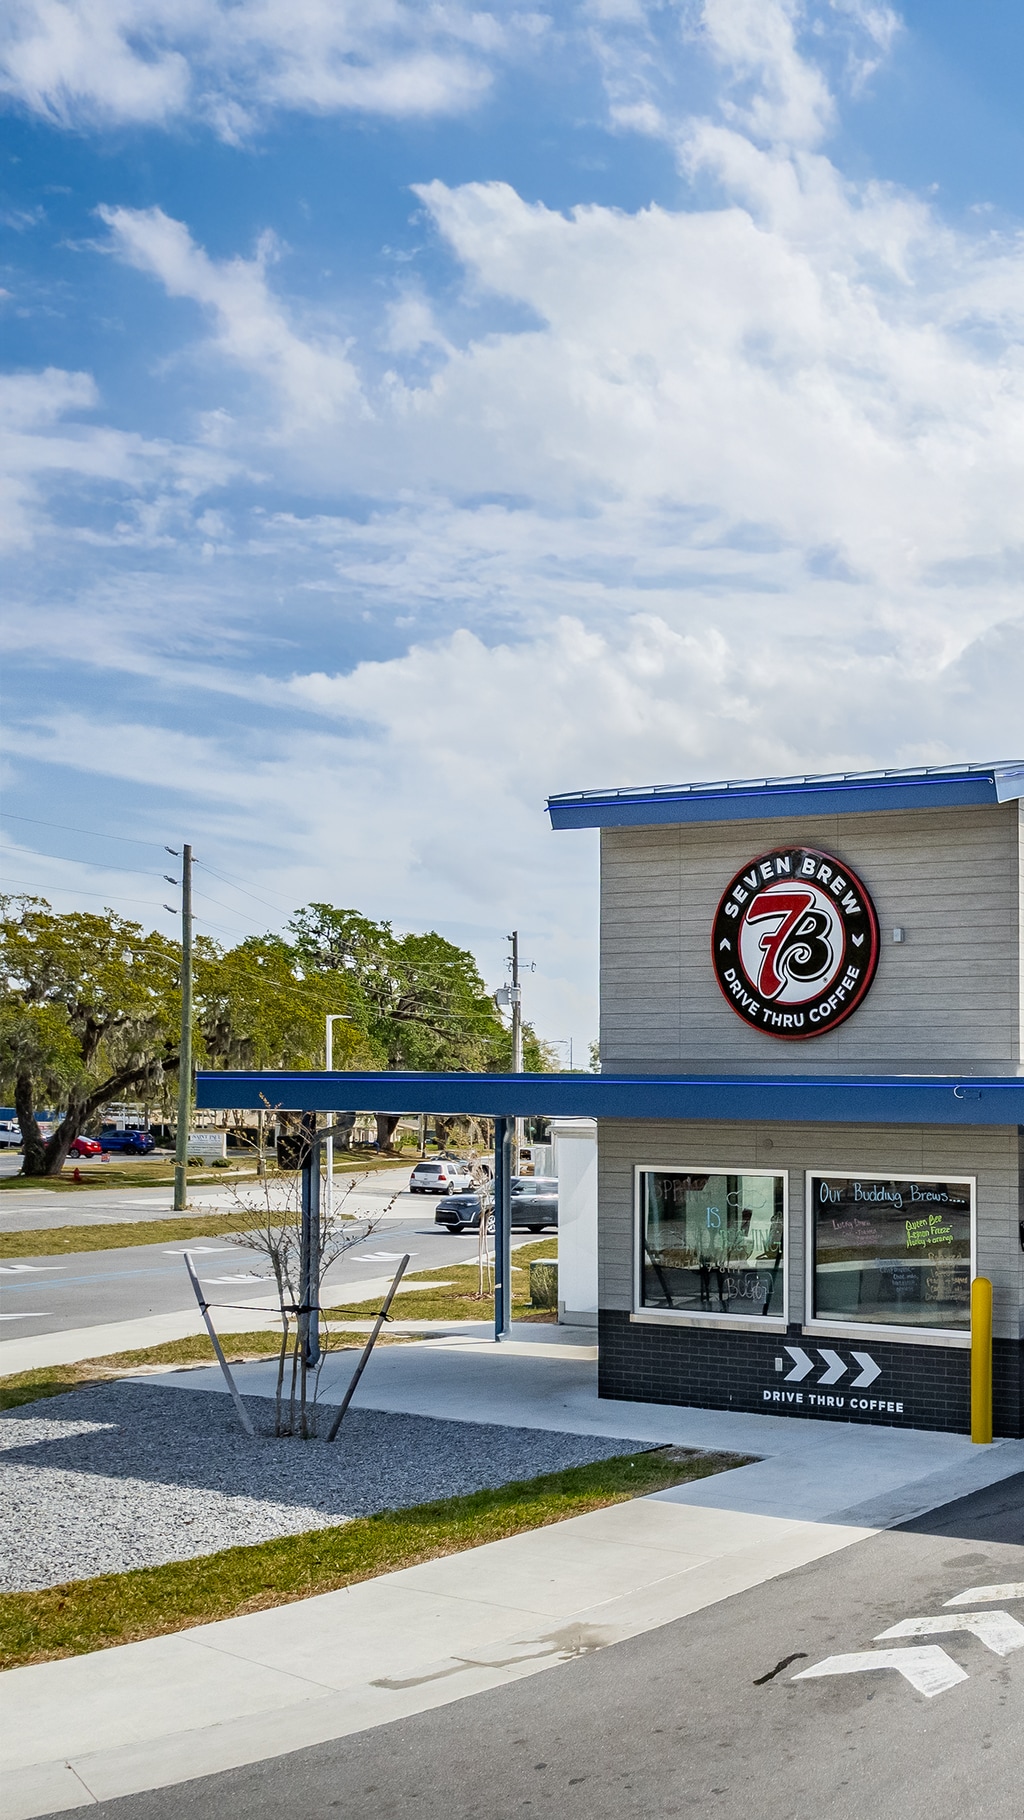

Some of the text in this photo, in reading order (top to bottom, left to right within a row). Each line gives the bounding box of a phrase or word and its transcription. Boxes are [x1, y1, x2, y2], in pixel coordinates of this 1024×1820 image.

[725, 856, 861, 918] SEVEN BREW
[745, 891, 833, 999] 7B
[724, 965, 860, 1028] DRIVE THRU COFFEE
[820, 1182, 843, 1203] Our
[854, 1182, 903, 1208] Budding
[706, 1207, 721, 1228] IS
[928, 1214, 942, 1226] Bee
[763, 1390, 904, 1413] DRIVE THRU COFFEE
